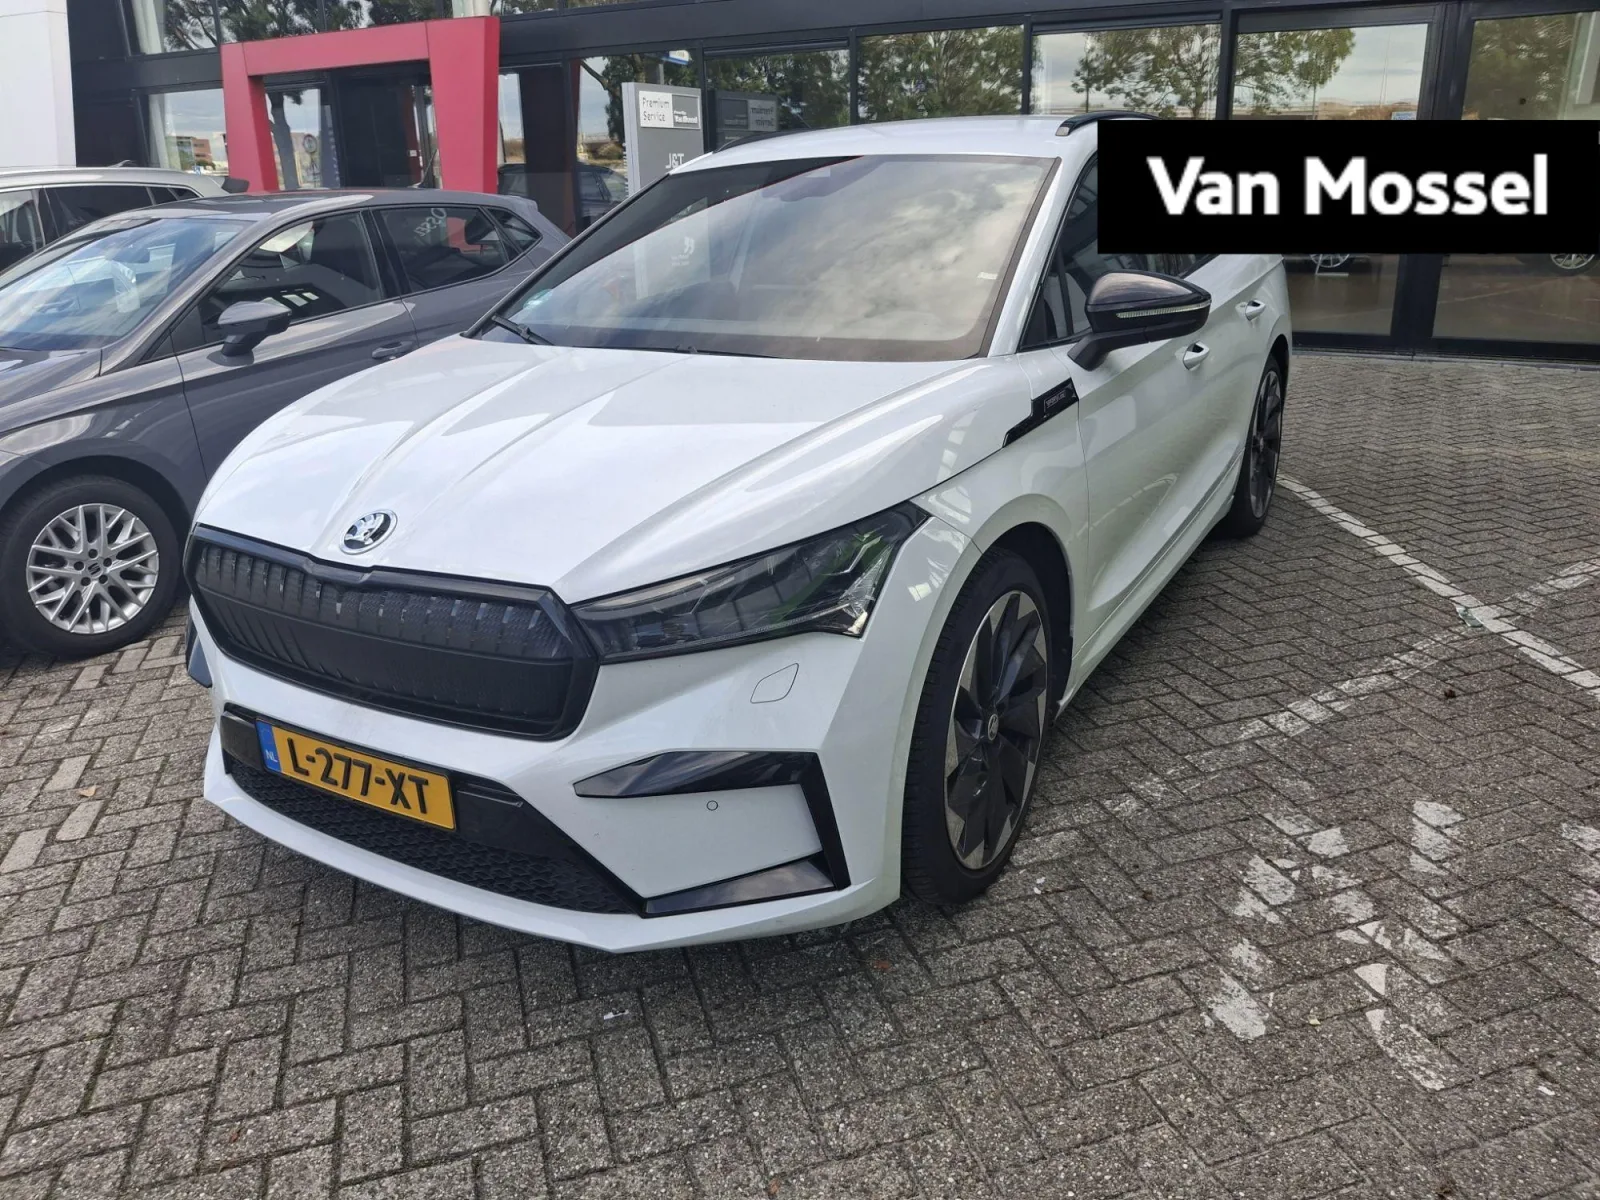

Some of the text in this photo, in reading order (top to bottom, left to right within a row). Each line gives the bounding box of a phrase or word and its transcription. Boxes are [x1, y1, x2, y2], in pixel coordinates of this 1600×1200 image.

[642, 97, 670, 109] Premium
[643, 110, 666, 122] Service
[265, 750, 279, 763] NL
[287, 737, 429, 815] L-277-XT
